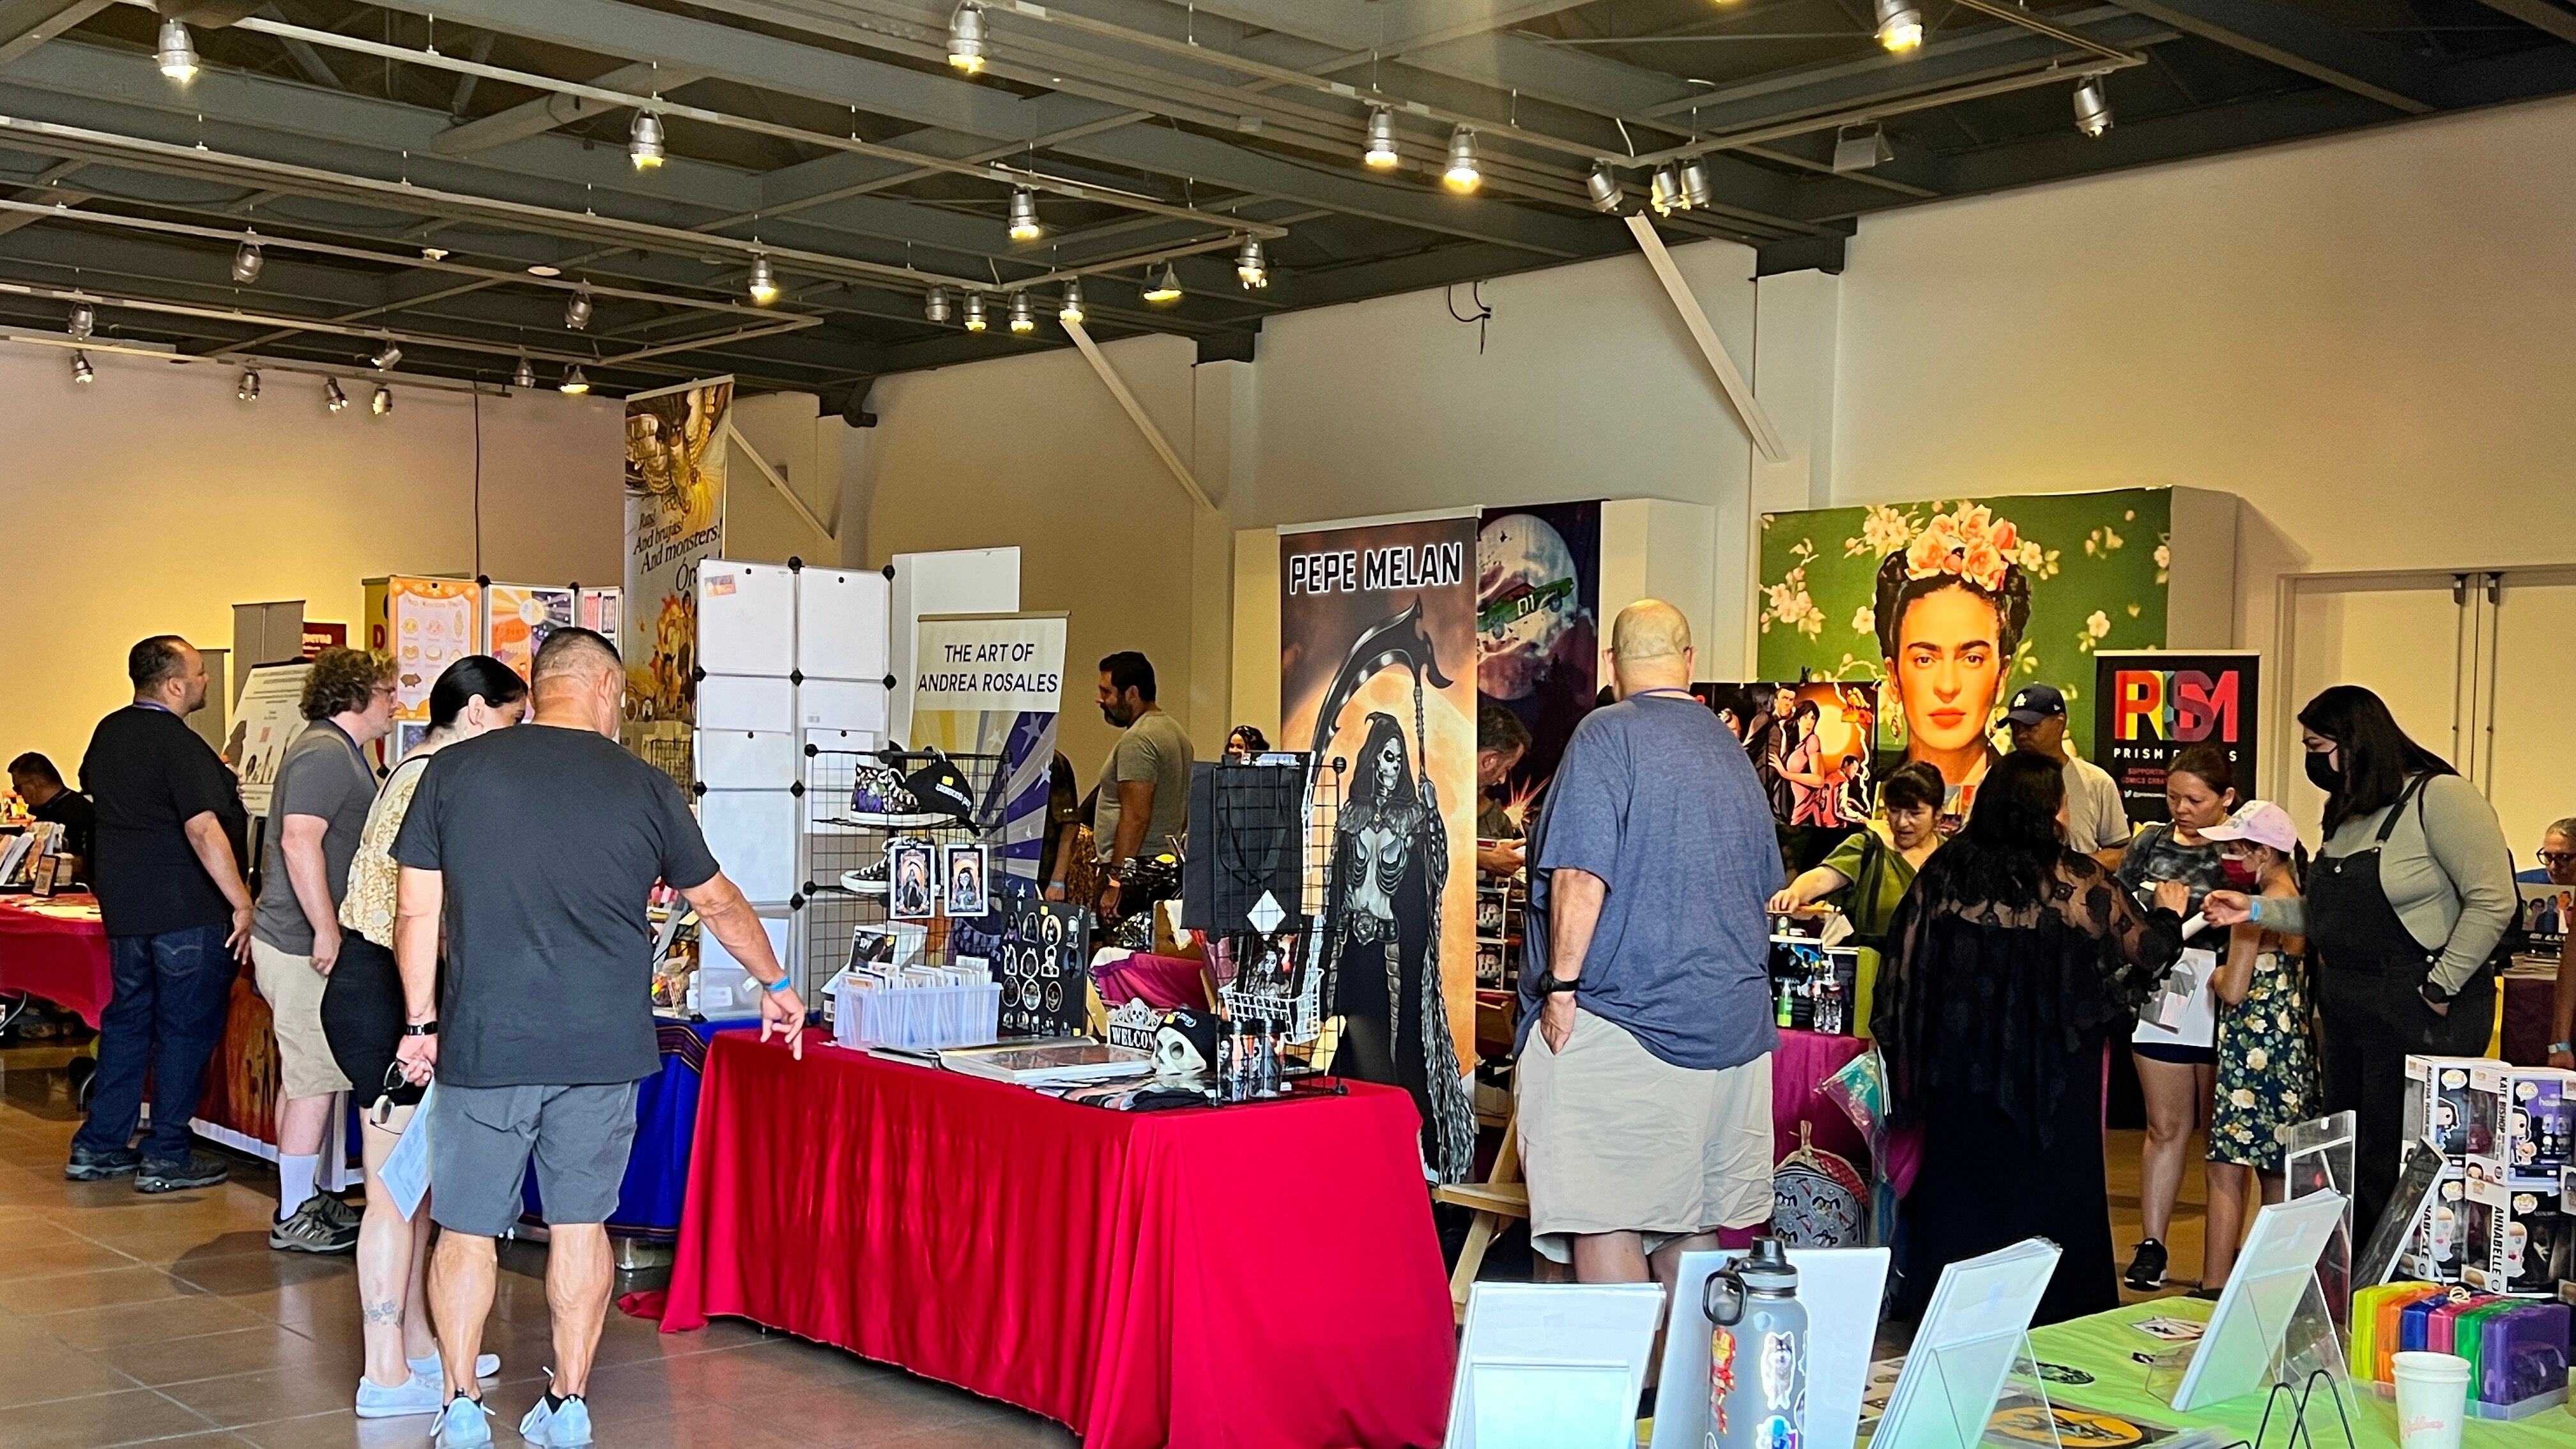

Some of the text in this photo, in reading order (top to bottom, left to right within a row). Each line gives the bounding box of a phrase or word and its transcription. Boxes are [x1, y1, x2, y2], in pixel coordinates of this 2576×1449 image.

[633, 515, 684, 555] And brujas!
[641, 516, 723, 574] And monsters!
[1290, 542, 1462, 595] PEPE MELAN
[944, 643, 1034, 663] THE ART OF
[917, 673, 1058, 693] ANDREA ROSALES
[2113, 747, 2163, 759] PRISM
[1112, 1027, 1154, 1049] WELCO
[2499, 1077, 2508, 1098] KATE
[2498, 1101, 2506, 1133] BISHOP
[2492, 1206, 2504, 1276] ANNABELLE
